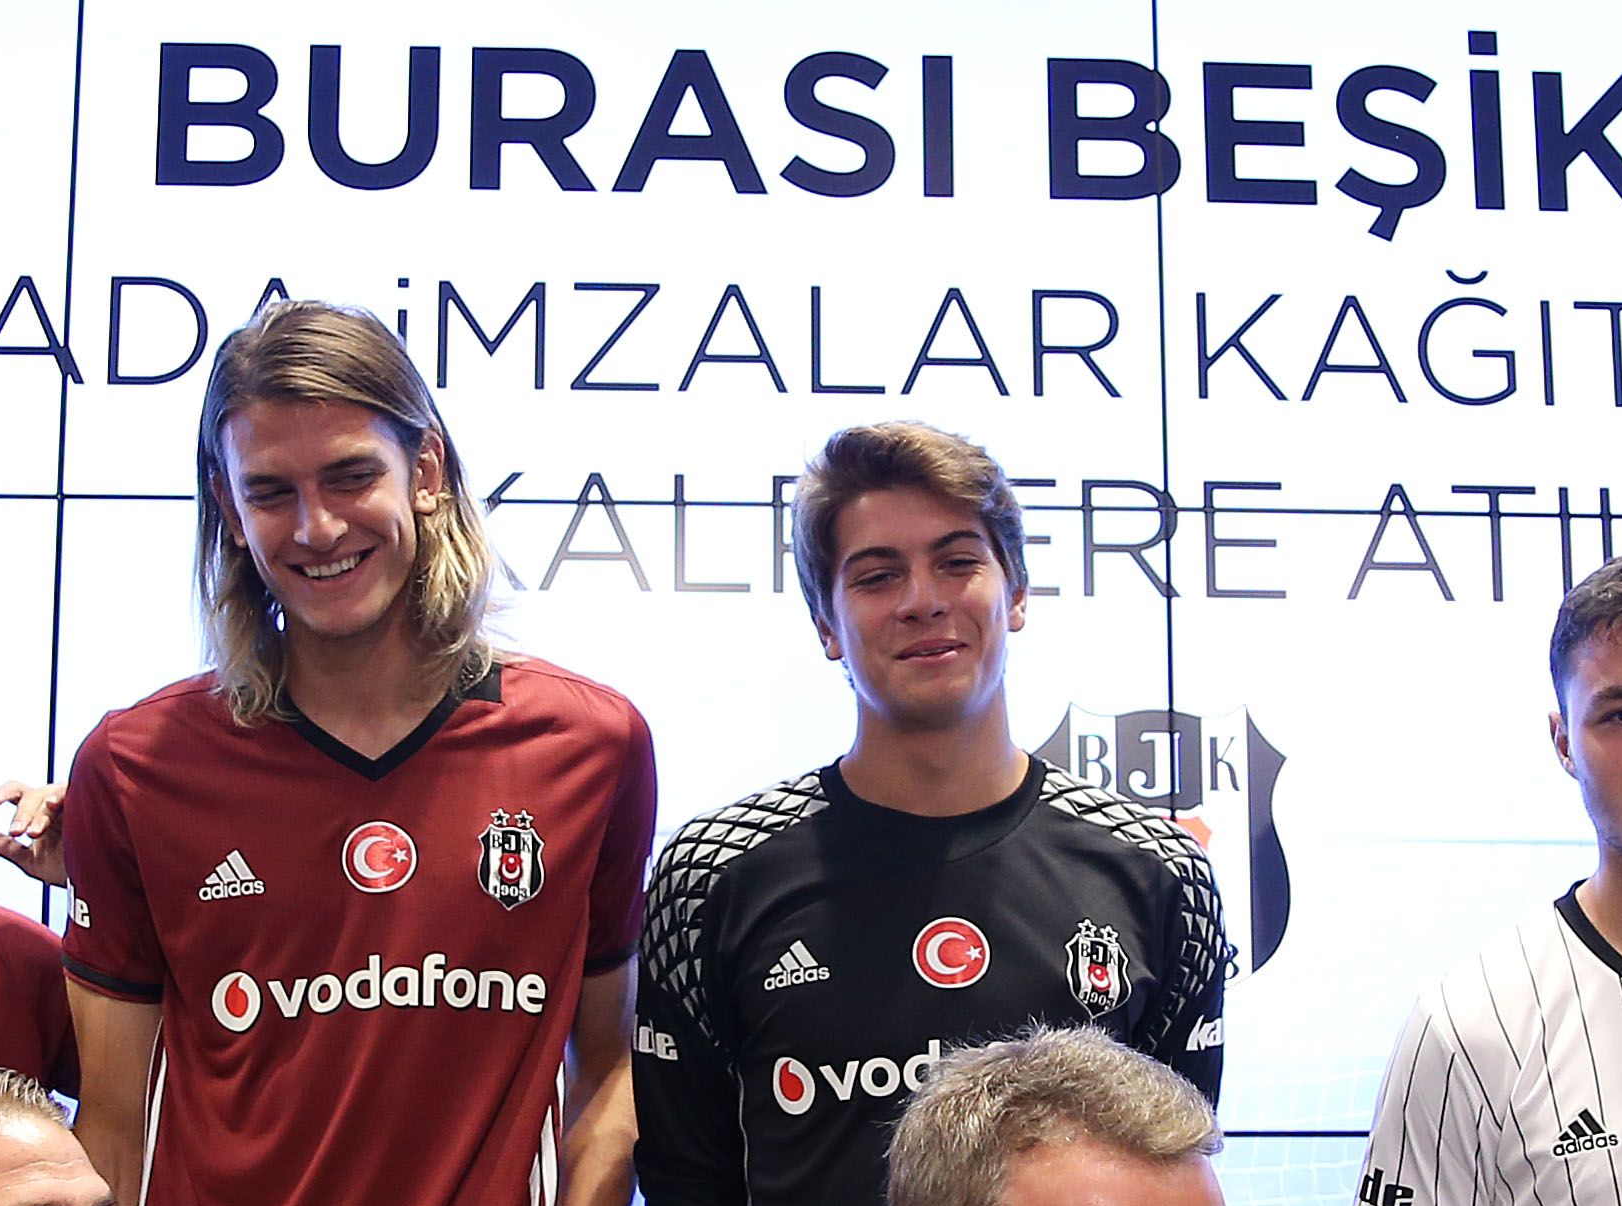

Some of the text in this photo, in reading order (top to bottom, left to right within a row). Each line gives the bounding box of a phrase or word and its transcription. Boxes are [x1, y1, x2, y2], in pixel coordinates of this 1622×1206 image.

[153, 41, 956, 198] BURASI
[1077, 731, 1240, 798] BJK
[198, 879, 266, 901] adidas
[267, 953, 548, 1019] vodafone
[763, 965, 830, 991] adidas
[1552, 1133, 1619, 1157] adidas
